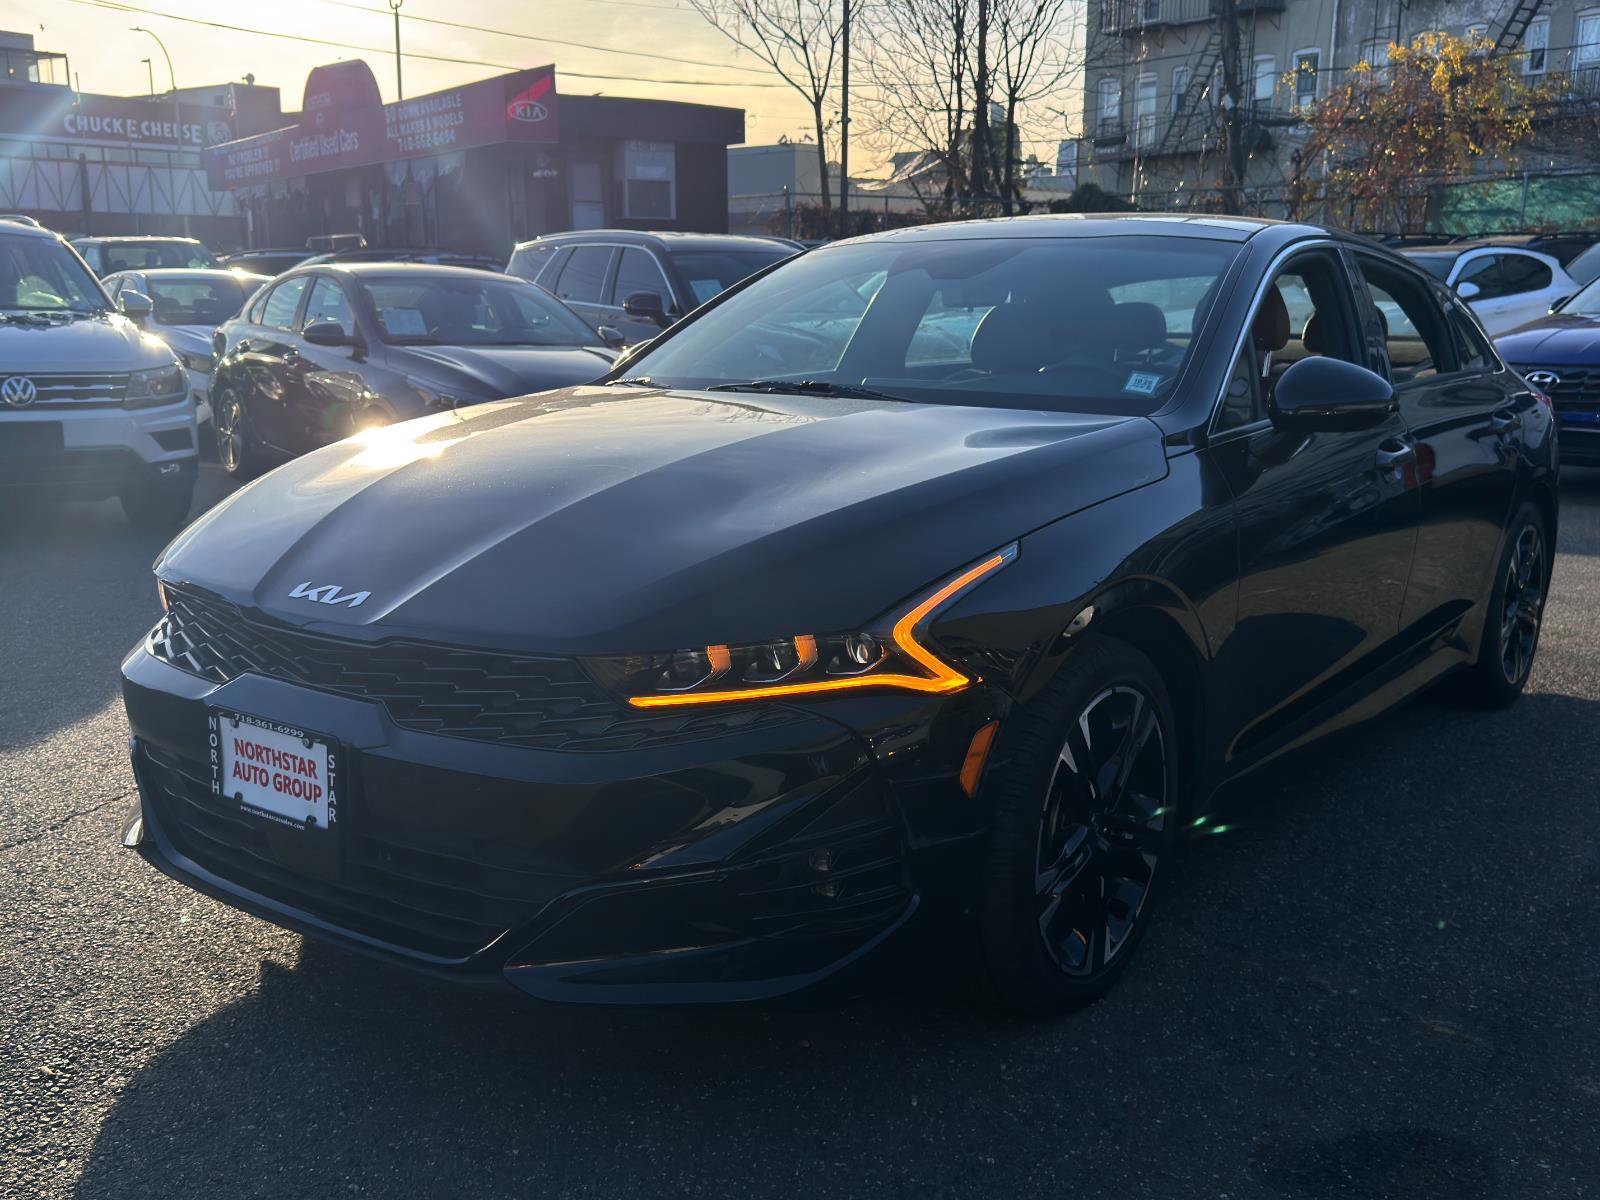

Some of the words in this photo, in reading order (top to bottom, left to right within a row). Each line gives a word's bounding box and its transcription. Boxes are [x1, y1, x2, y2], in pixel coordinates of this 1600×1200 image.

[63, 114, 124, 135] CHUCK
[515, 104, 543, 118] KIA
[340, 128, 360, 152] Cars
[208, 716, 220, 795] NORTH
[233, 737, 318, 780] NORTHSTAR
[233, 760, 270, 788] AUTO
[272, 772, 323, 803] GROUP
[328, 754, 337, 822] STAR
